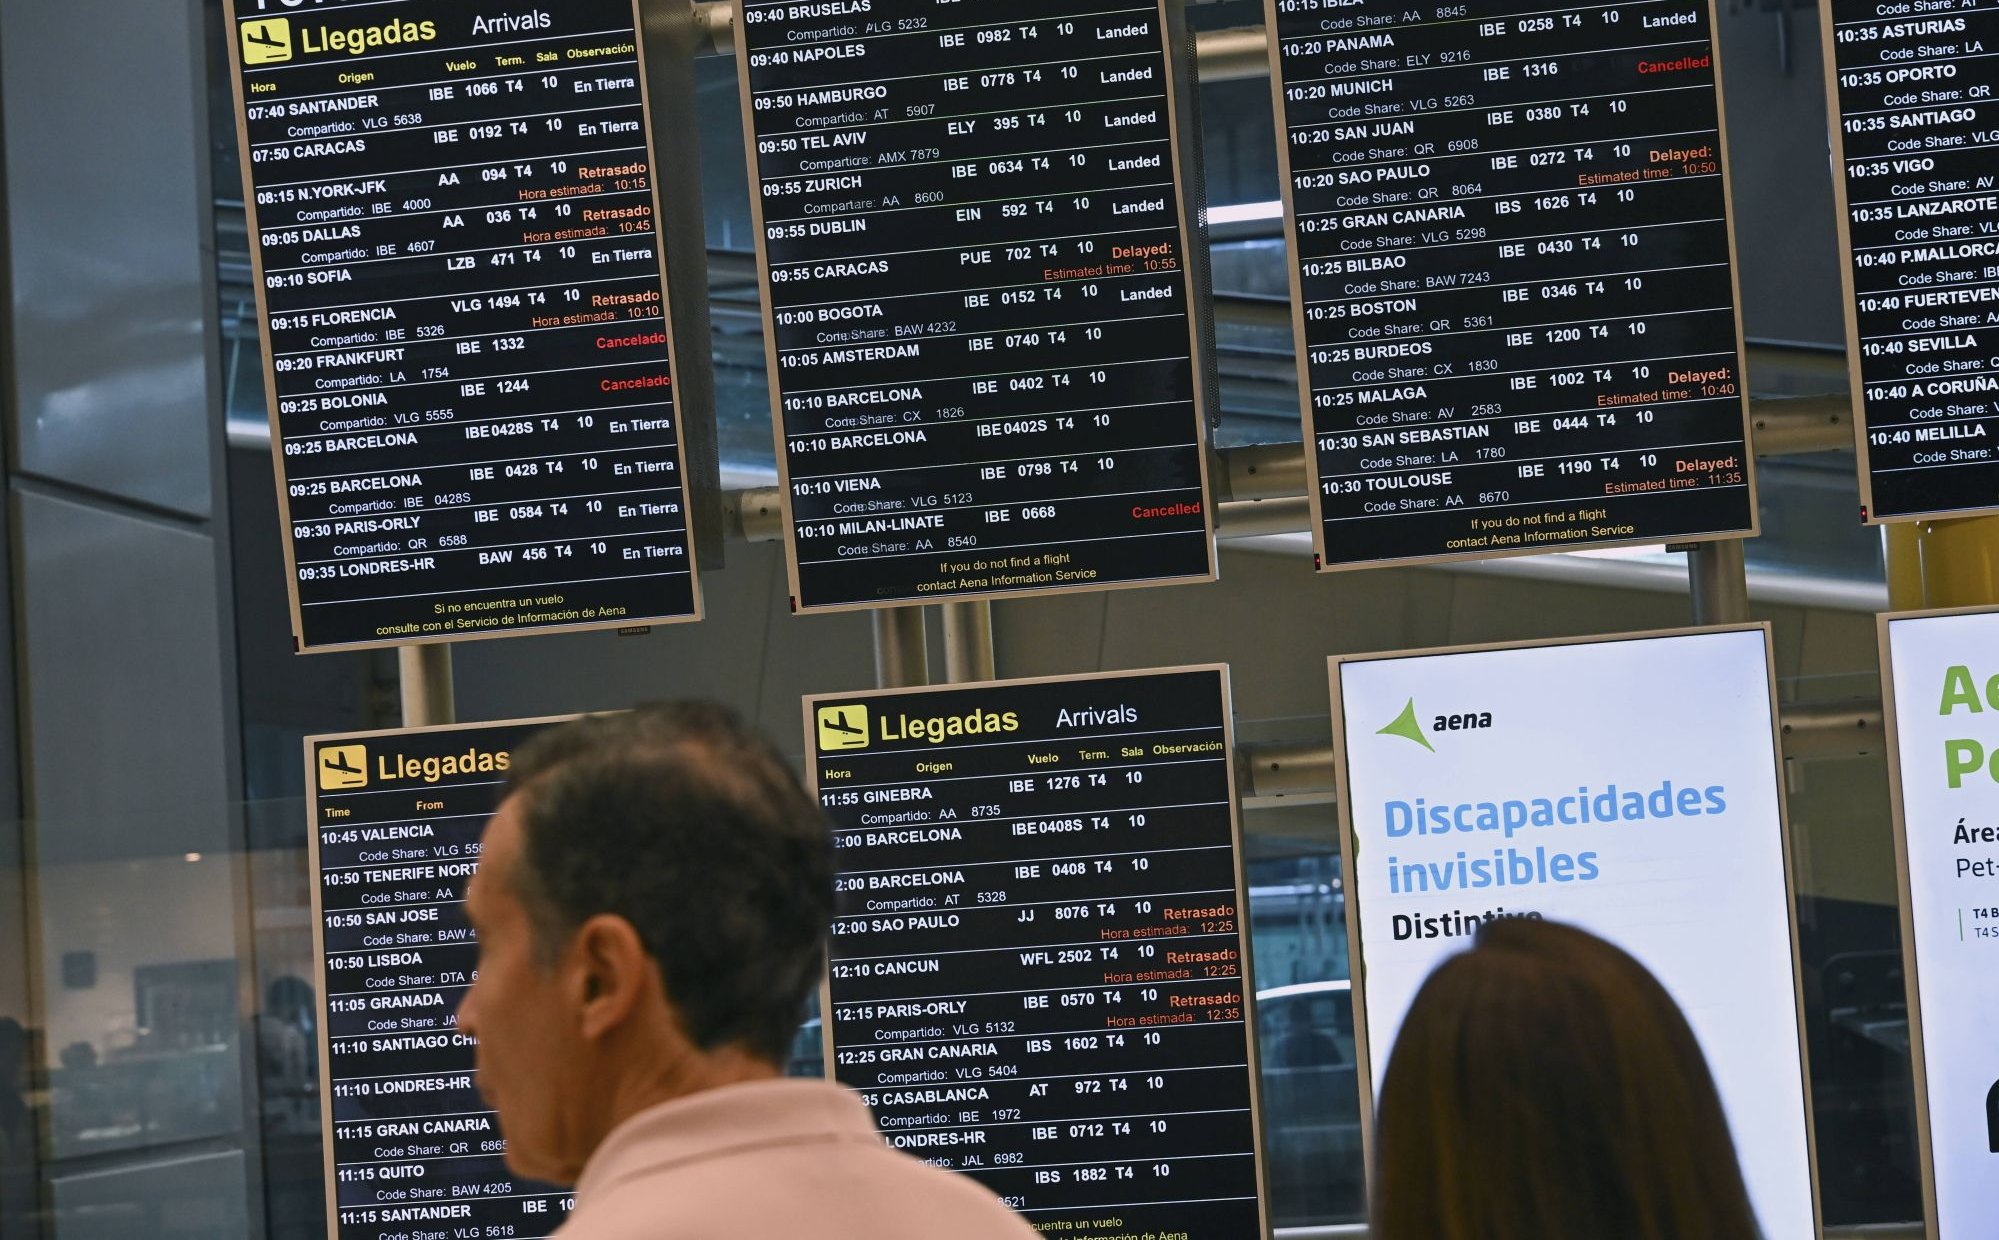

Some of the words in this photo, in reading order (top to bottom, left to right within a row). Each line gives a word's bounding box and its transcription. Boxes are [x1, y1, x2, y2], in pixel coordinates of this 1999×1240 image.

[1642, 10, 1697, 28] Landed
[1836, 26, 1878, 43] 10:35
[1881, 17, 1966, 39] ASTURIAS
[301, 17, 436, 54] Llegadas
[472, 9, 551, 35] Arrivals
[1283, 41, 1322, 56] 10:20
[1326, 33, 1394, 52] PANAMA
[1479, 21, 1506, 37] IBE
[1518, 17, 1554, 32] 0258
[1562, 13, 1582, 28] T4
[1601, 10, 1619, 24] 10
[251, 83, 276, 92] Hora
[338, 72, 374, 83] Origen
[445, 60, 476, 72] Vuelo
[494, 56, 525, 66] Term.
[536, 51, 558, 62] Sala
[566, 43, 634, 59] Observación
[1324, 61, 1357, 74] Code
[1360, 58, 1400, 70] Share:
[1406, 53, 1430, 67] ELY
[1439, 49, 1470, 63] 9216
[573, 80, 592, 93] En
[594, 77, 635, 91] Tierra
[1100, 66, 1152, 83] Landed
[248, 104, 285, 120] 07:40
[288, 94, 379, 116] SANTANDER
[428, 86, 454, 101] IBE
[465, 81, 498, 97] 1066
[504, 78, 523, 92] T4
[541, 75, 558, 89] 10
[755, 95, 793, 110] 09:50
[796, 85, 887, 106] HAMBURGO
[943, 76, 969, 91] IBE
[980, 72, 1015, 87] 0778
[1022, 69, 1041, 83] T4
[1060, 65, 1077, 79] 10
[287, 121, 355, 137] Compartido:
[361, 116, 388, 129] VLG
[393, 112, 422, 126] 5638
[1844, 116, 1886, 133] 10:35
[1889, 107, 1976, 128] SANTIAGO
[578, 162, 647, 179] Retrasado
[1848, 161, 1889, 178] 10:35
[1892, 157, 1934, 173] VIGO
[257, 189, 295, 204] 08:15
[297, 179, 387, 201] N.YORK-JFK
[438, 172, 460, 186] AA
[481, 167, 507, 182] 094
[513, 164, 532, 178] T4
[550, 160, 567, 174] 10
[518, 189, 547, 200] Hora
[549, 183, 604, 197] estimada:
[614, 177, 646, 190] 10:15
[1890, 183, 1925, 196] Code
[1928, 180, 1970, 192] Share:
[1975, 175, 1994, 188] AV
[296, 205, 364, 221] Compartido:
[371, 201, 392, 214] IBE
[402, 197, 431, 211] 4000
[1299, 217, 1338, 233] 10:25
[1342, 212, 1388, 229] GRAN
[1392, 205, 1465, 224] CANARIA
[1494, 200, 1521, 214] IBS
[1534, 195, 1569, 210] 1626
[1577, 192, 1597, 206] T4
[1616, 188, 1634, 202] 10
[771, 267, 810, 282] 09:55
[813, 260, 889, 278] CARACAS
[960, 250, 991, 265] PUE
[1005, 246, 1031, 261] 702
[1039, 243, 1058, 257] T4
[1077, 240, 1093, 253] 10
[1112, 242, 1172, 259] Delayed:
[596, 332, 666, 349] Cancelado
[780, 352, 818, 368] 10:05
[822, 343, 920, 364] AMSTERDAM
[968, 337, 994, 351] IBE
[1005, 333, 1039, 348] 0740
[1047, 330, 1066, 344] T4
[1085, 327, 1101, 340] 10
[276, 356, 313, 371] 09:20
[316, 347, 405, 368] FRANKFURT
[455, 340, 481, 355] IBE
[492, 336, 525, 351] 1332
[1870, 430, 1911, 445] 10:40
[1915, 423, 1986, 442] MELILLA
[1322, 479, 1361, 494] 10:30
[1365, 471, 1452, 491] TOULOUSE
[1517, 463, 1544, 478] IBE
[1557, 459, 1592, 474] 1190
[1600, 457, 1619, 470] T4
[1639, 454, 1657, 467] 10
[1675, 456, 1738, 472] Delayed:
[1605, 478, 1665, 494] Estimated
[1669, 477, 1698, 488] time:
[1708, 472, 1741, 484] 11:35
[797, 523, 835, 538] 10:10
[839, 514, 944, 535] MILAN-LINATE
[984, 509, 1010, 523] IBE
[1021, 505, 1056, 520] 0668
[1132, 502, 1200, 518] Cancelled
[916, 579, 956, 591] contact
[959, 578, 987, 588] Aena
[991, 573, 1052, 585] Information
[1055, 568, 1096, 580] Service
[880, 708, 1019, 743] Llegadas
[1055, 703, 1138, 728] Arrivals
[1433, 711, 1493, 731] aena
[378, 747, 511, 783] Llegadas
[825, 769, 851, 779] Hora
[916, 761, 953, 773] Origen
[1027, 752, 1059, 764] Vuelo
[1078, 750, 1109, 760] Term.
[1121, 746, 1143, 757] Sala
[1152, 740, 1222, 754] Observación
[821, 792, 859, 806] 11:55
[863, 786, 933, 803] GINEBRA
[1009, 779, 1035, 793] IBE
[1046, 775, 1080, 790] 1276
[1087, 773, 1107, 787] T4
[1125, 770, 1142, 784] 10
[325, 808, 350, 817] Time
[416, 800, 443, 810] From
[1384, 781, 1726, 837] Discapacidades
[322, 830, 358, 844] 10:45
[360, 824, 434, 841] VALENCIA
[1388, 847, 1600, 893] invisibles
[1973, 908, 1988, 919] T4
[1974, 927, 1989, 938] T4
[328, 956, 364, 970] 10:50
[367, 951, 423, 967] LISBOA
[832, 963, 870, 978] 12:10
[874, 959, 939, 975] CANCUN
[1019, 951, 1054, 966] WFL
[1057, 949, 1092, 963] 2502
[1099, 946, 1118, 960] T4
[1137, 944, 1154, 958] 10
[1167, 948, 1237, 963] Retrasado
[1104, 972, 1132, 983] Hora
[1136, 968, 1194, 981] estimada:
[1203, 964, 1236, 976] 12:25
[334, 1083, 370, 1097] 11:10
[374, 1076, 471, 1094] LONDRES-HR
[338, 1167, 374, 1182] 11:15
[378, 1164, 425, 1179] QUITO
[376, 1189, 406, 1200] Code
[409, 1187, 446, 1198] Share:
[451, 1184, 480, 1196] BAW
[483, 1182, 512, 1194] 4205
